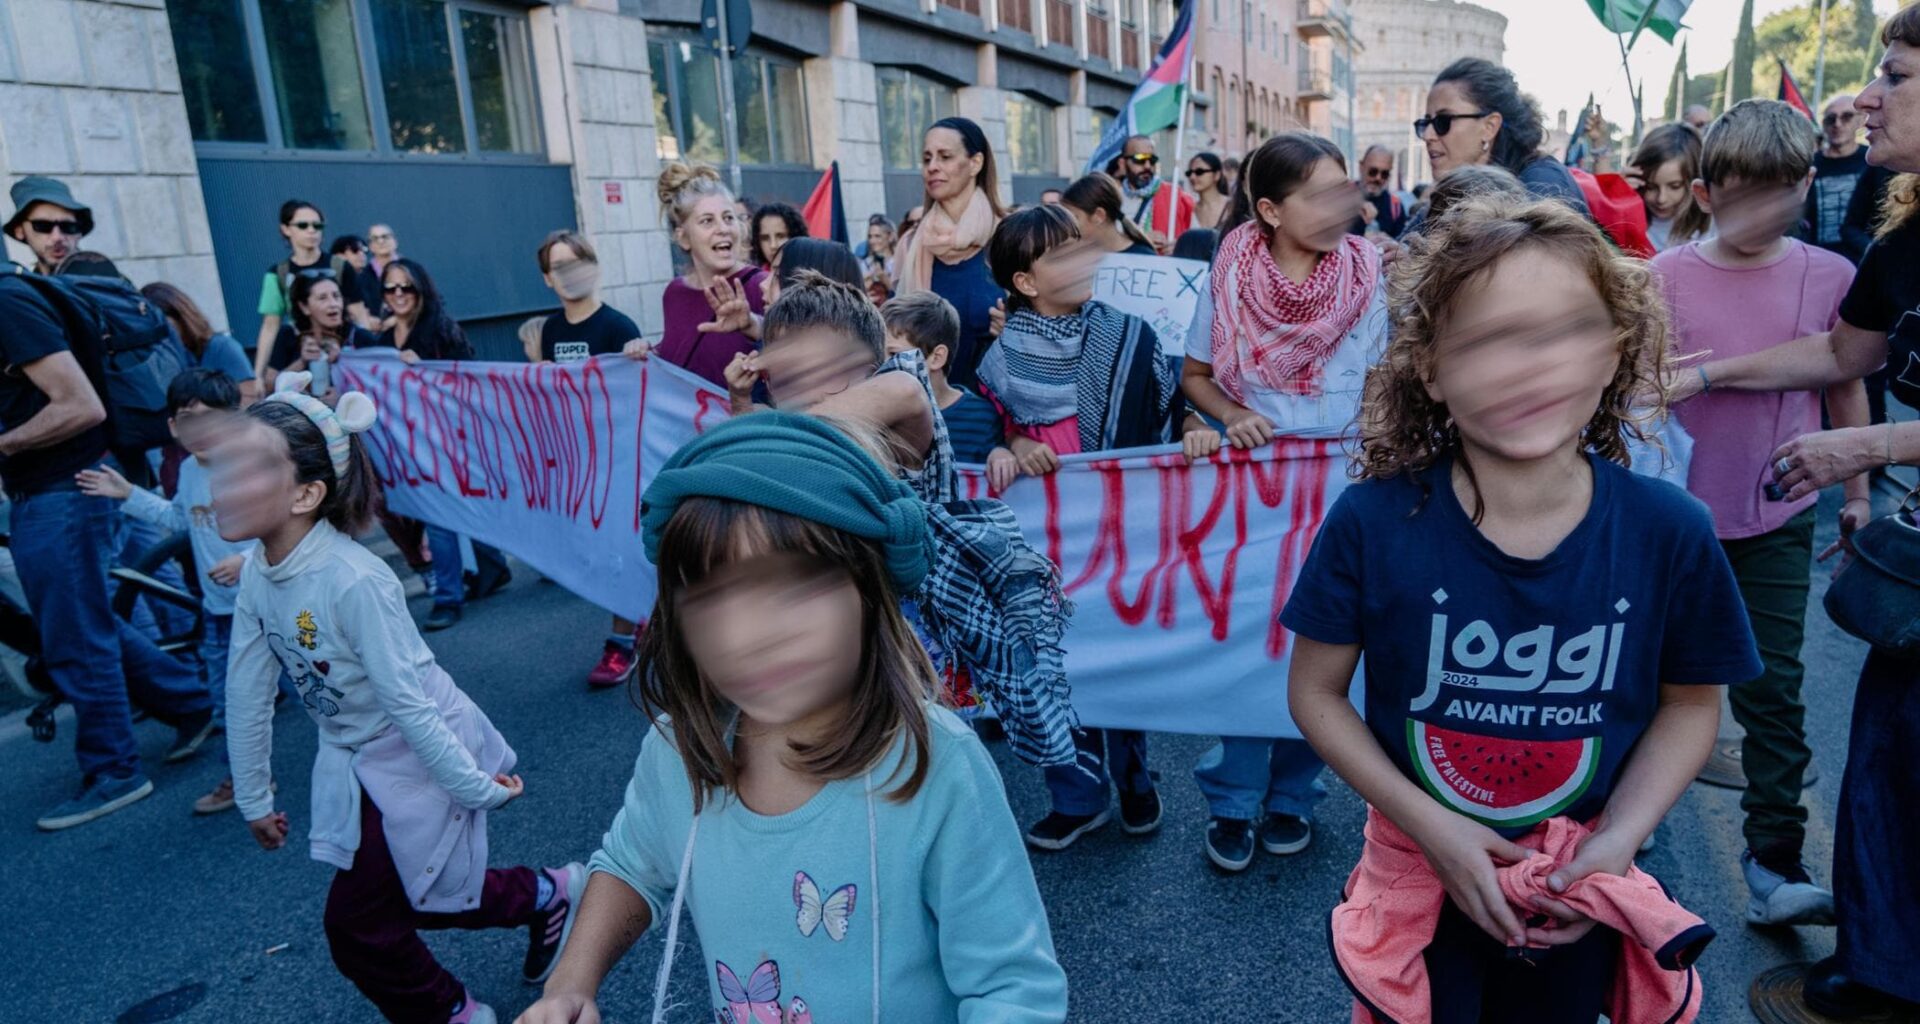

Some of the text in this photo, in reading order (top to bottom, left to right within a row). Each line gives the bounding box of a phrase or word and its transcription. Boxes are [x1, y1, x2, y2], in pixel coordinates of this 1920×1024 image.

[1094, 266, 1167, 300] FREE
[556, 344, 587, 355] SUPER
[1409, 587, 1631, 711] joggi
[1442, 672, 1479, 687] 2024
[1444, 699, 1603, 726] AVANT FOLK
[1429, 736, 1496, 803] FREE PALESTINE
